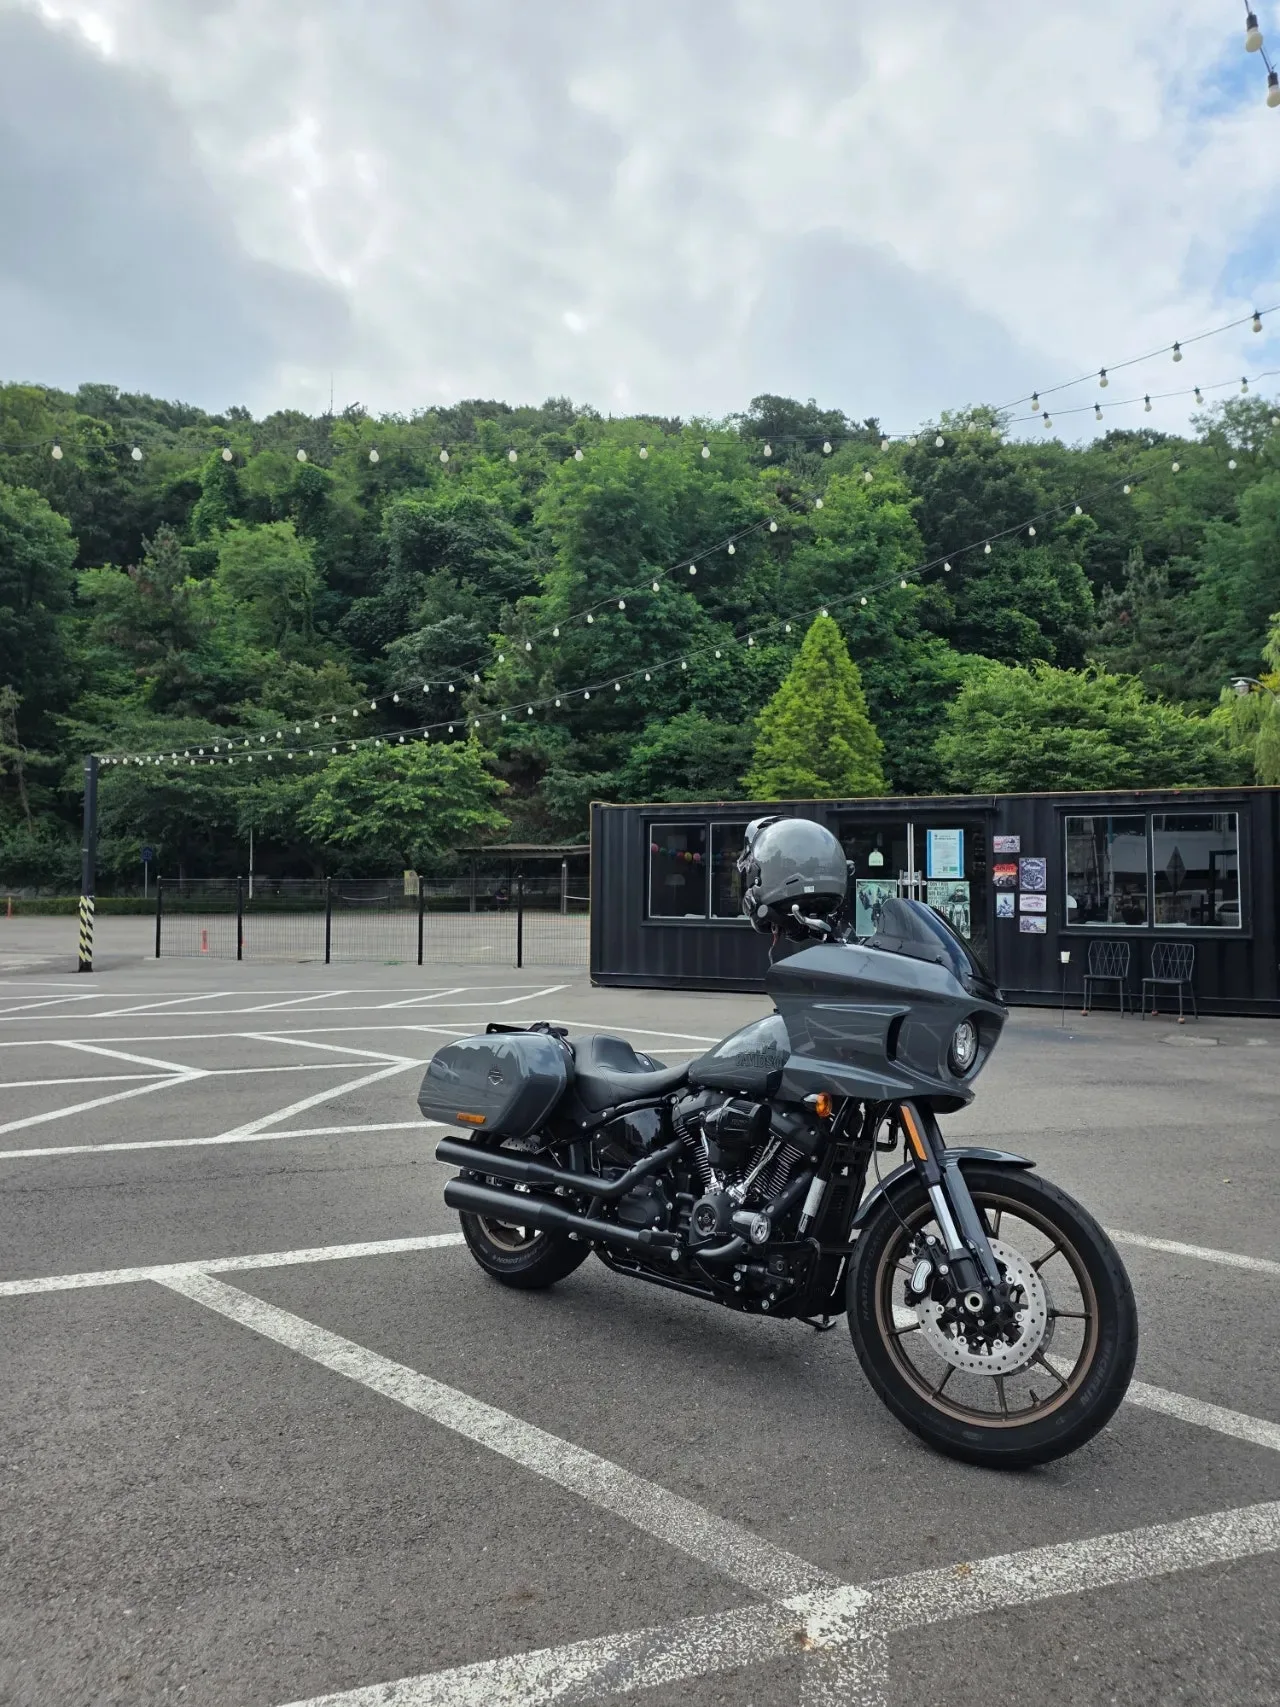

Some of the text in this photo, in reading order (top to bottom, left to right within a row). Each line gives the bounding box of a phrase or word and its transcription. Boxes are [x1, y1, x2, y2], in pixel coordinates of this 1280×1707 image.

[997, 876, 1013, 886] 66
[736, 1053, 786, 1071] DAVIDSO
[1079, 1338, 1113, 1407] MICHELIN
